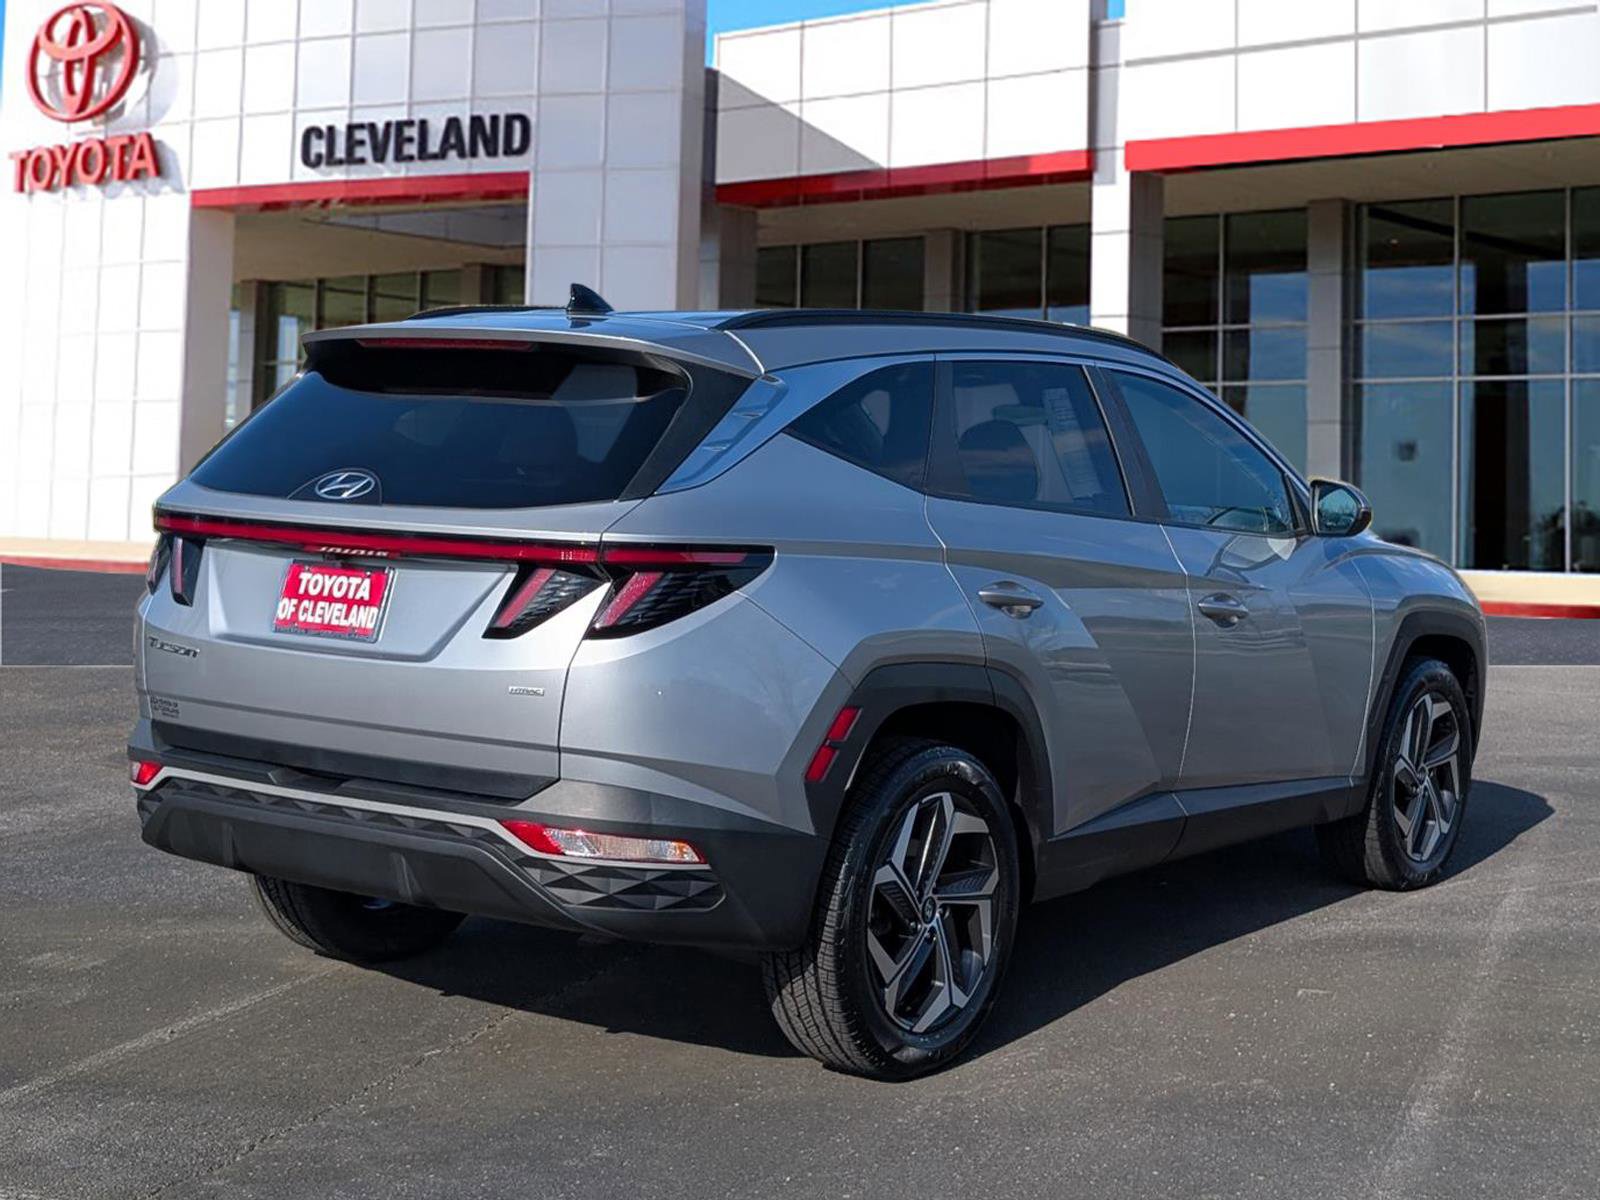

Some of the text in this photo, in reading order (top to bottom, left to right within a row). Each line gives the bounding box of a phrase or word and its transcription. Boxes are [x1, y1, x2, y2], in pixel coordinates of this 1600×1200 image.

[9, 132, 161, 193] TOYOTA
[301, 113, 531, 169] CLEVELAND
[298, 572, 371, 601] TOYOTA
[276, 597, 379, 629] OF CLEVELAND
